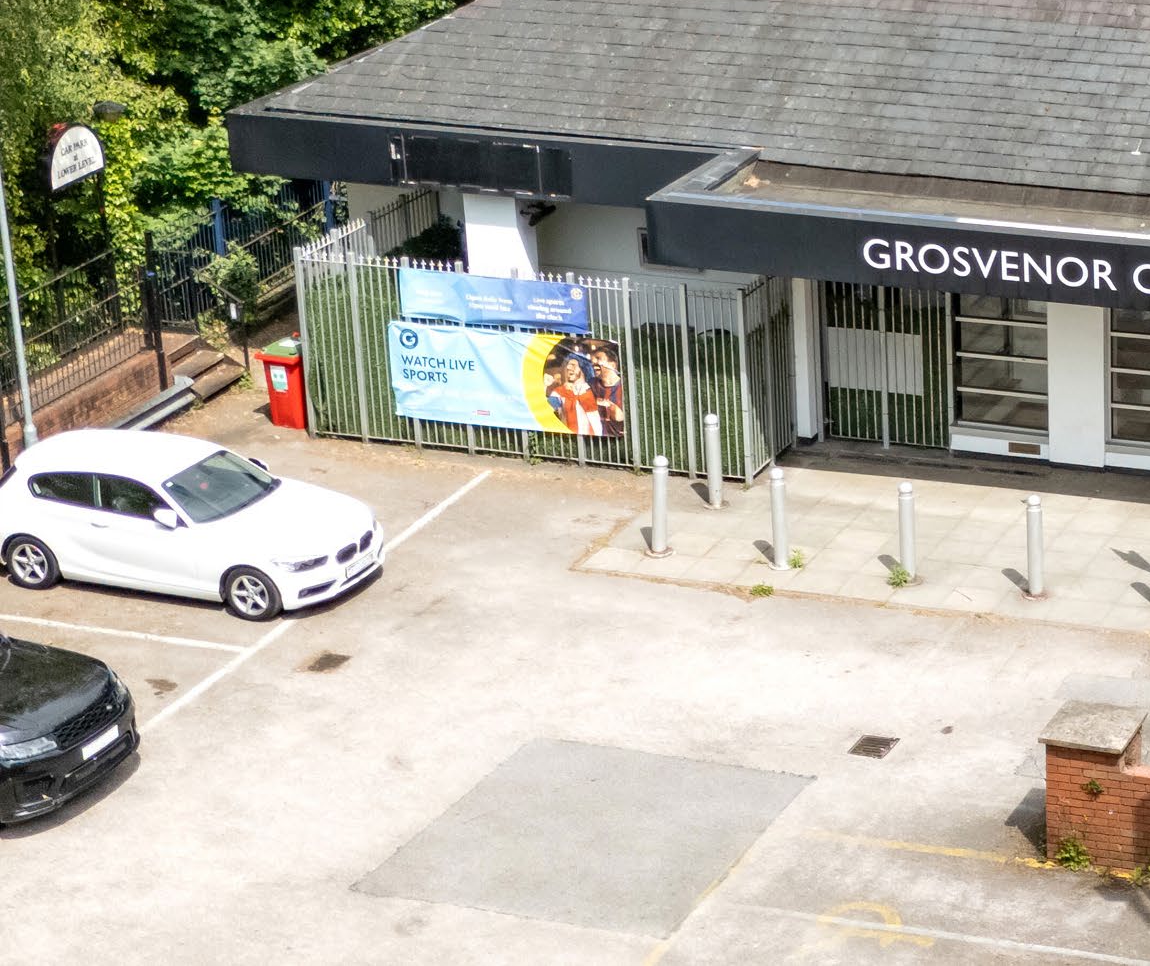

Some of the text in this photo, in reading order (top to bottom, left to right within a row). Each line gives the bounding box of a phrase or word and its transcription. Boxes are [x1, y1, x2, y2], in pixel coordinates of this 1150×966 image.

[862, 238, 1117, 292] GROSVENOR
[401, 354, 475, 370] WATCH LIVE
[402, 369, 448, 383] SPORTS
